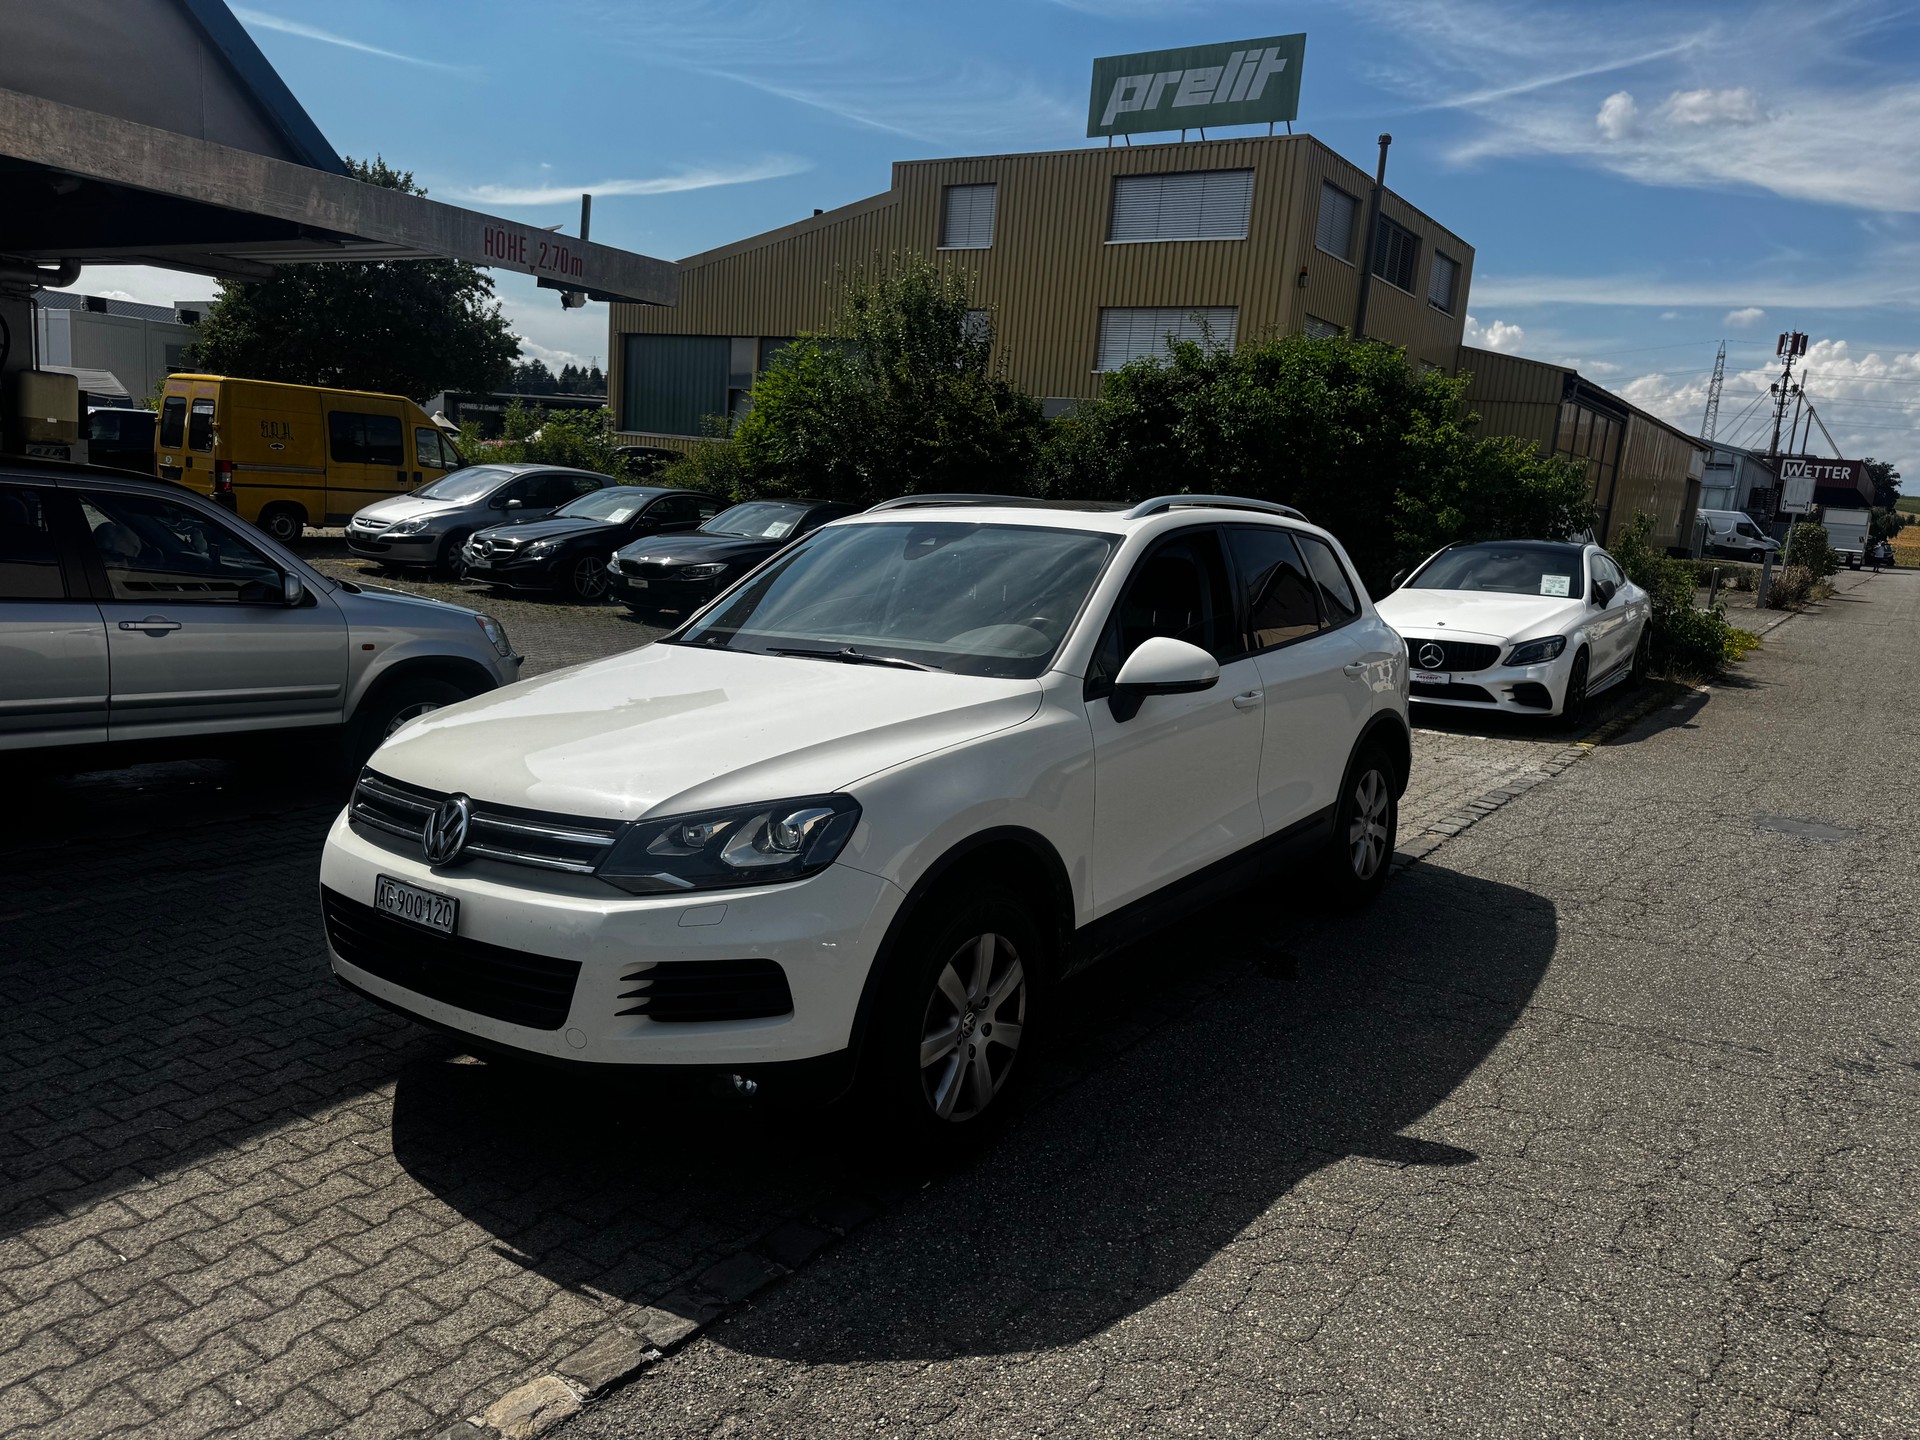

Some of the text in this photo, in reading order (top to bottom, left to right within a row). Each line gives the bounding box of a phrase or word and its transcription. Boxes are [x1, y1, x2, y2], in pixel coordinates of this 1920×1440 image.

[1100, 47, 1288, 127] prelit
[484, 224, 527, 264] HÖHE
[1785, 460, 1852, 480] WETTER
